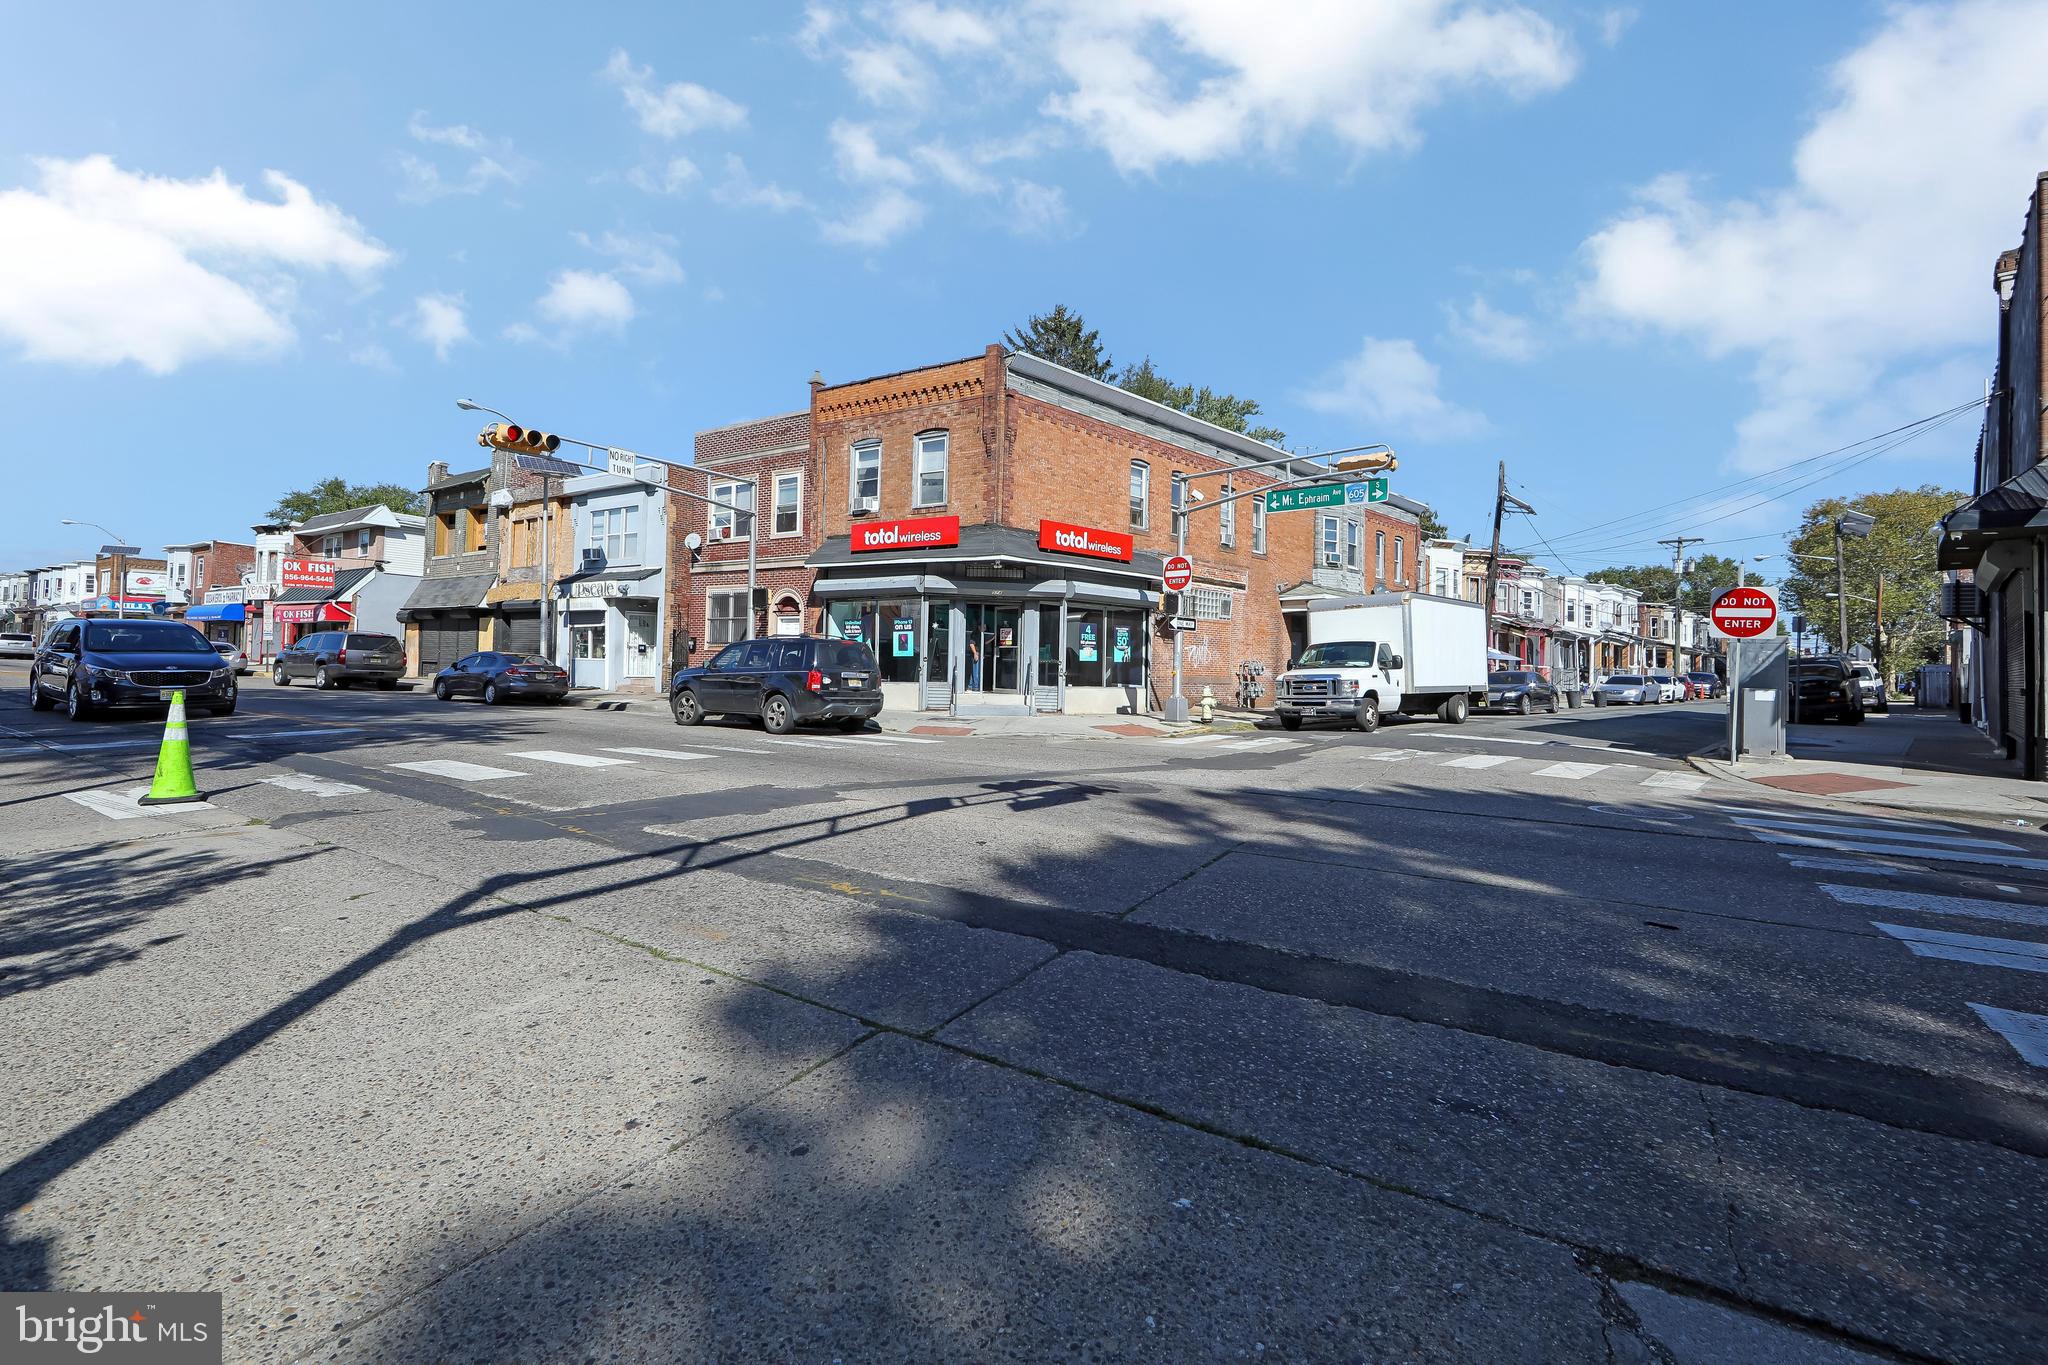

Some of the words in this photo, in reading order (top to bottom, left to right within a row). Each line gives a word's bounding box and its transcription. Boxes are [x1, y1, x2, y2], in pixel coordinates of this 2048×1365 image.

[610, 451, 619, 461] NO
[620, 453, 634, 463] RIGHT
[613, 464, 631, 475] TURN
[1348, 488, 1365, 499] 605
[1282, 495, 1294, 506] Mt.
[1298, 493, 1330, 505] Ephraim
[864, 525, 899, 545] total
[899, 531, 941, 542] wireless
[1055, 530, 1088, 549] total
[1088, 541, 1121, 554] wireless
[283, 561, 301, 571] OK
[308, 563, 334, 573] FISH
[284, 573, 333, 582] 856-964-5445
[1721, 597, 1736, 606] DO
[1743, 597, 1767, 606] NOT
[283, 610, 294, 619] OK
[295, 609, 314, 618] FISH
[1724, 619, 1761, 628] ENTER
[1085, 625, 1091, 634] 4
